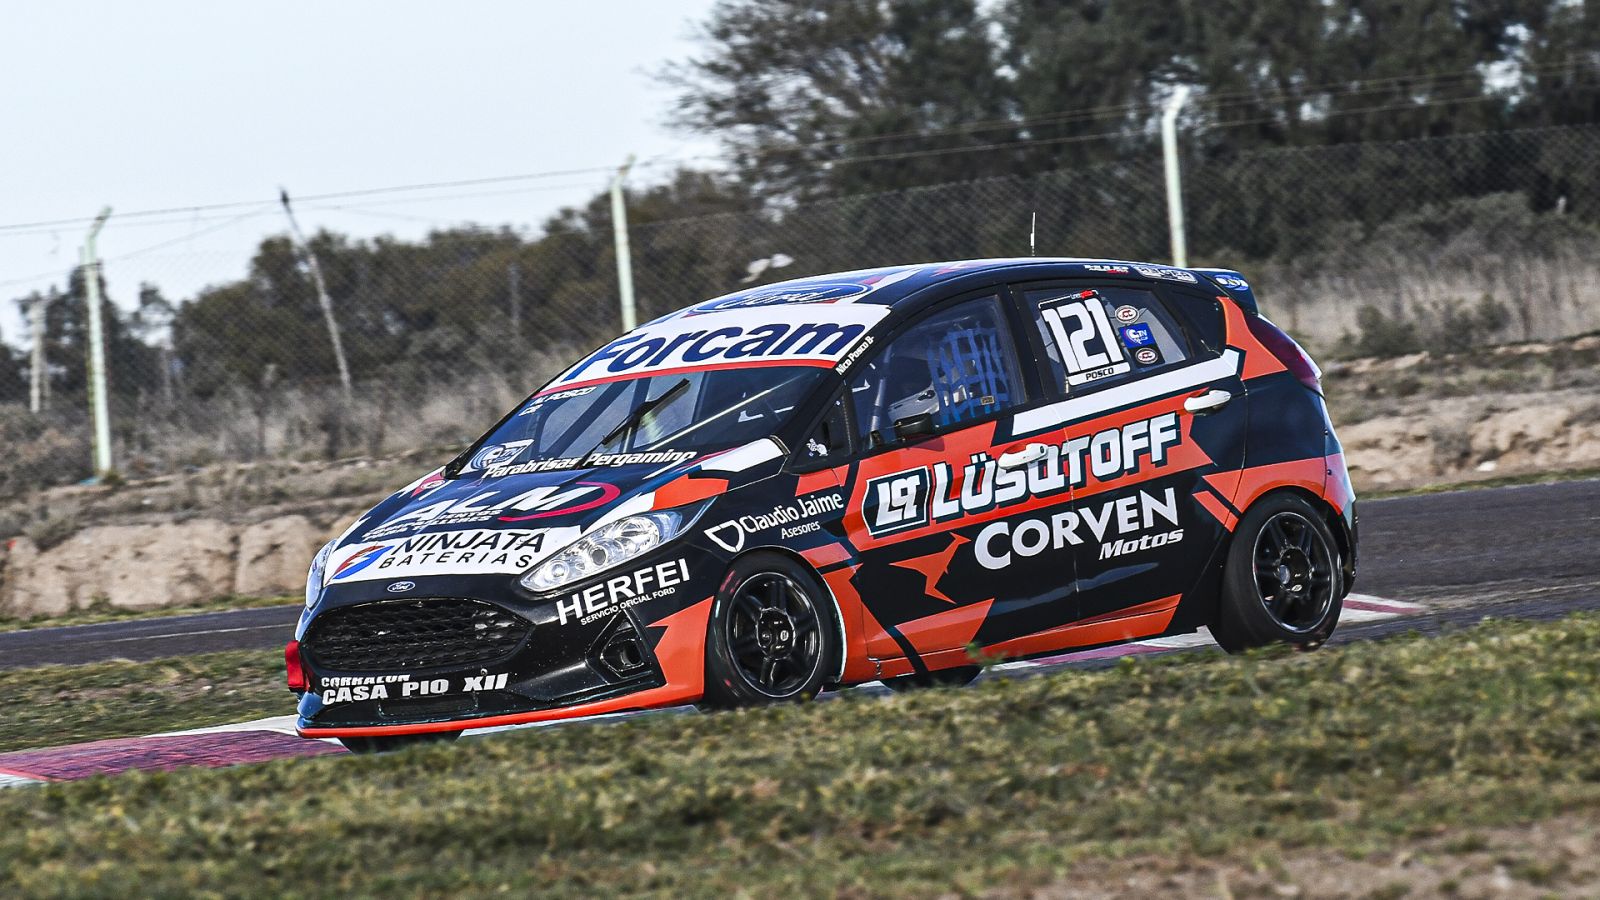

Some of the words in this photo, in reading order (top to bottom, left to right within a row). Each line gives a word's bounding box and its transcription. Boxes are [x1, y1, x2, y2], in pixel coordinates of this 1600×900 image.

[561, 323, 867, 382] Forcam
[1041, 298, 1124, 373] 121
[1086, 367, 1114, 381] POSCO
[481, 456, 582, 479] Parabrisas
[583, 449, 698, 467] Pergamino
[370, 486, 597, 532] ALM
[739, 505, 800, 533] Claudio
[797, 493, 844, 518] Jaime
[390, 531, 546, 556] NINJATA
[781, 521, 820, 539] Asesores
[974, 487, 1179, 570] CORVEN
[1099, 529, 1184, 560] Motos
[378, 551, 533, 569] BATERIAS
[556, 558, 690, 626] HERFEI
[580, 605, 619, 626] SERVICIO
[619, 595, 652, 609] OFICIAL
[652, 587, 676, 599] FORD
[322, 684, 389, 705] CASA
[402, 679, 449, 697] PIO
[463, 673, 509, 692] XII
